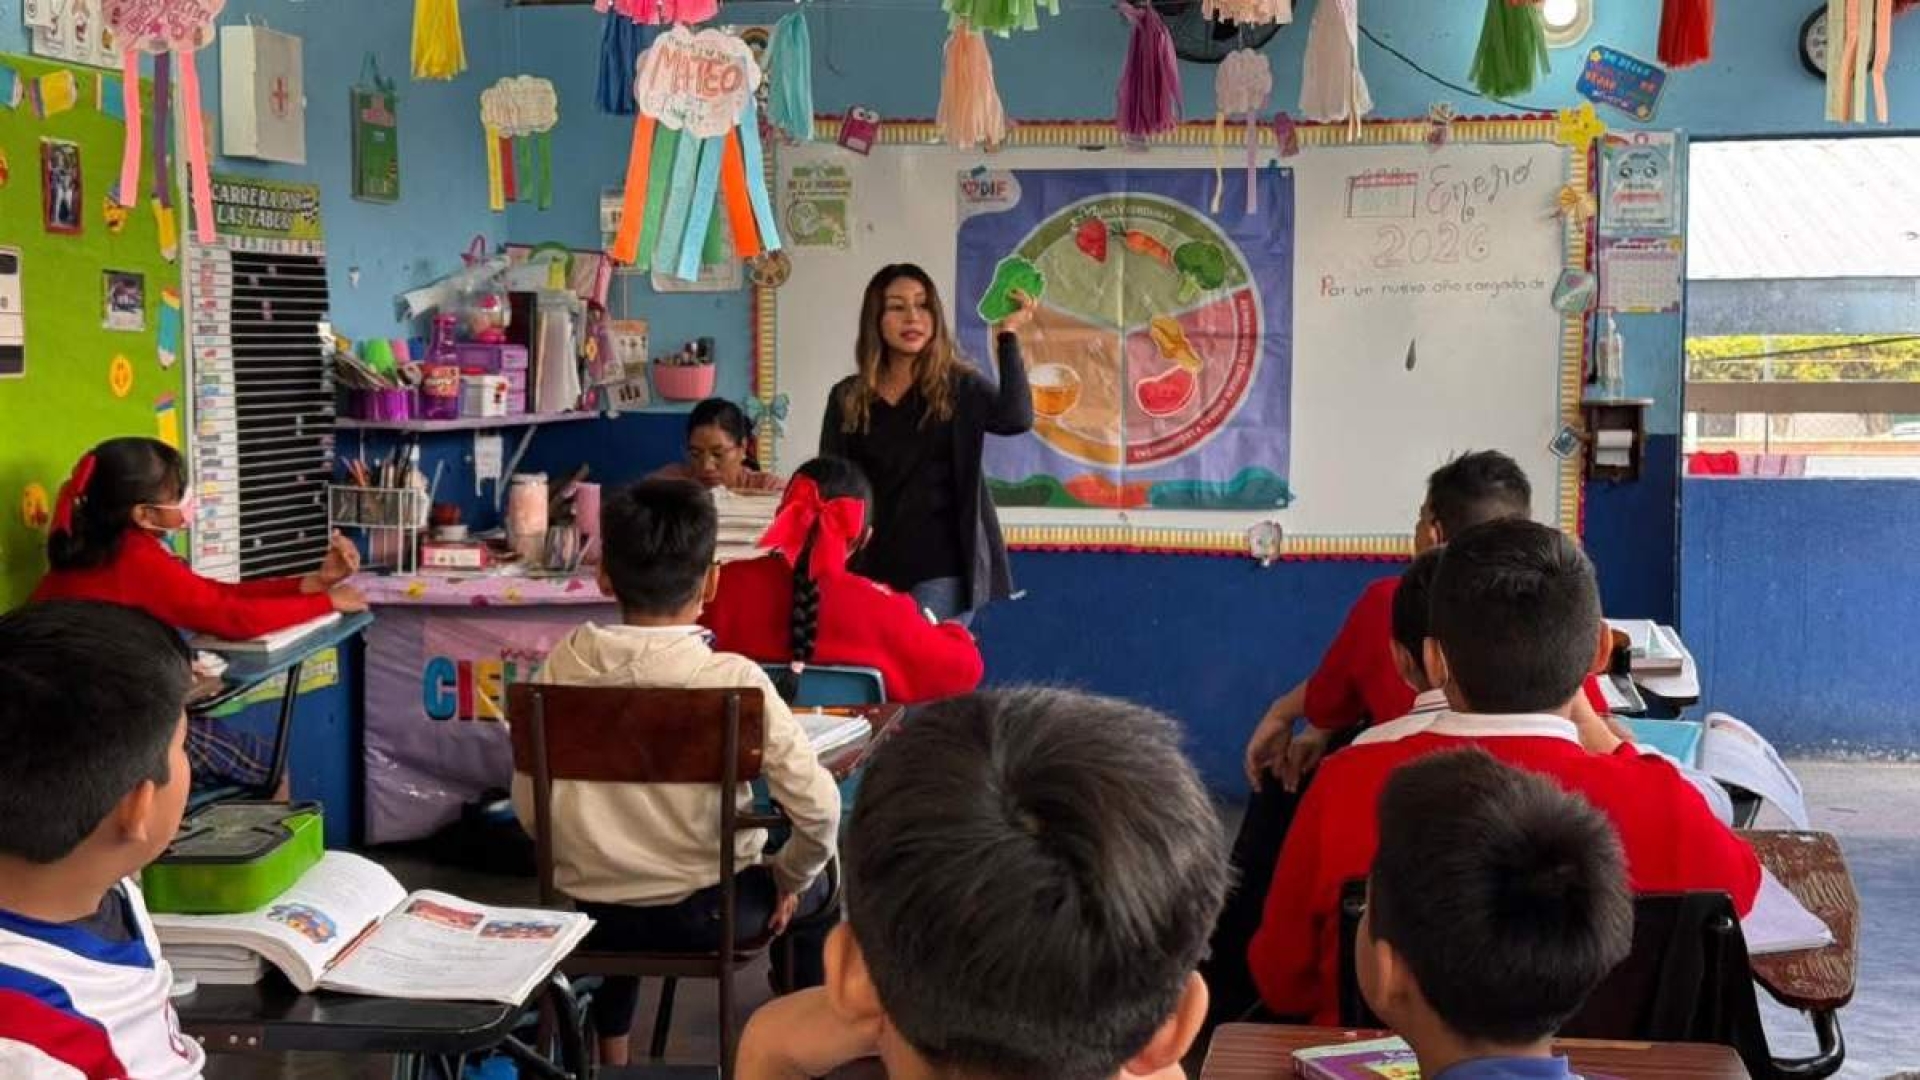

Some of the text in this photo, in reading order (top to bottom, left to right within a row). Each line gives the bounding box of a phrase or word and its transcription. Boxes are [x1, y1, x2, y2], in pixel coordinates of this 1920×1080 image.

[649, 44, 743, 97] MATEO
[980, 180, 1009, 196] DIF
[1426, 157, 1533, 224] Enero
[217, 203, 243, 225] LAS
[1374, 221, 1490, 268] 2026
[1355, 285, 1373, 296] un
[1382, 283, 1425, 295] nuevo
[1431, 278, 1462, 292] año
[1465, 277, 1526, 297] cargado
[1527, 277, 1545, 290] de
